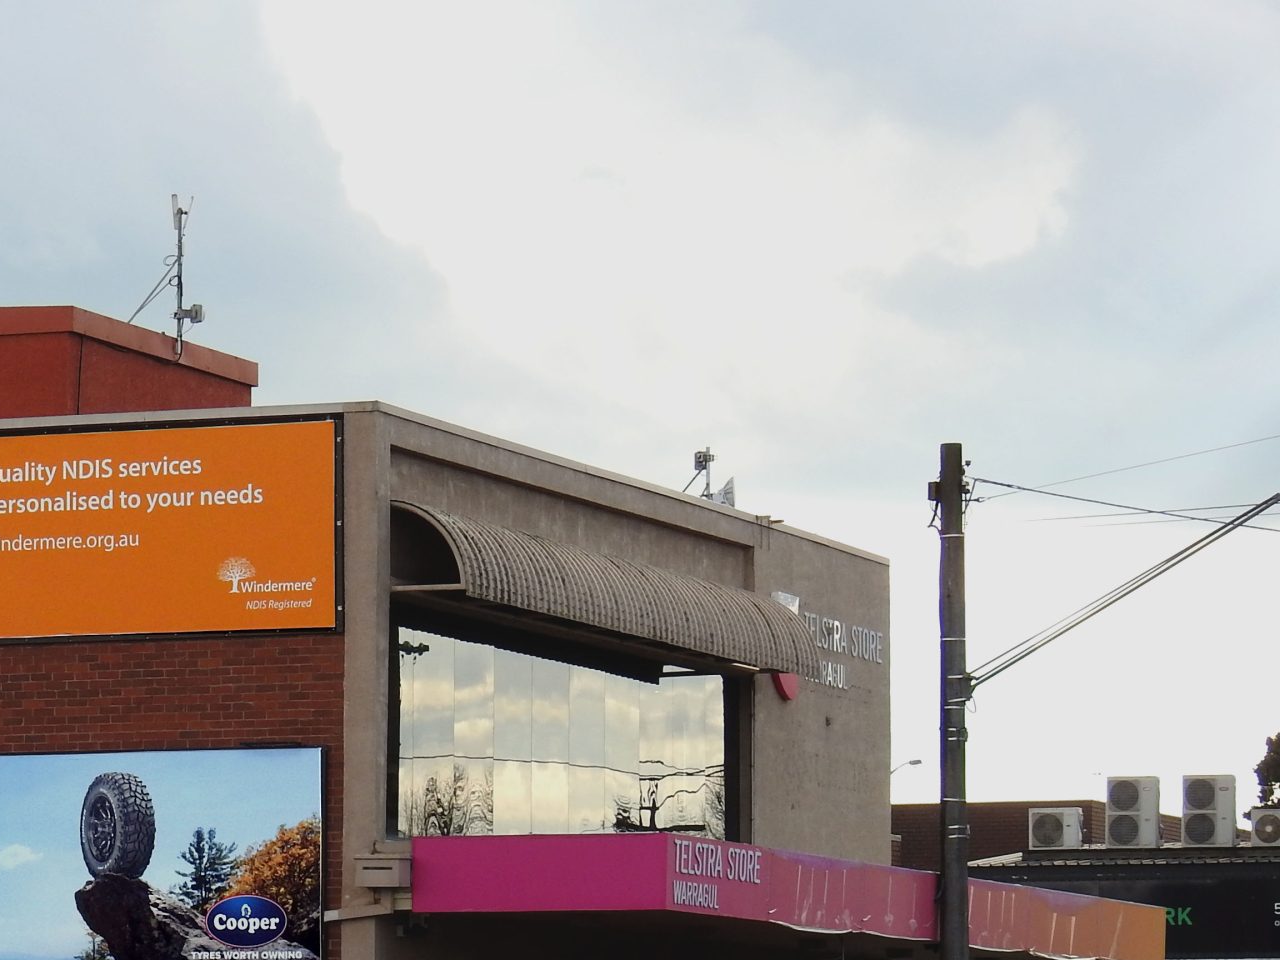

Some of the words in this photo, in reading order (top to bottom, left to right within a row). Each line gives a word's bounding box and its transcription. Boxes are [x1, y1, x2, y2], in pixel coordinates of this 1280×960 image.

[62, 458, 113, 480] NDIS
[118, 456, 202, 478] services
[120, 491, 141, 509] to
[146, 490, 194, 513] your
[200, 484, 264, 506] needs
[245, 600, 267, 610] NDIS
[268, 598, 313, 611] Registered
[851, 624, 883, 664] STORE
[674, 839, 723, 878] TELSTRA
[727, 847, 762, 884] STORE
[673, 880, 719, 909] WARRAGUL
[213, 913, 280, 934] Cooper
[191, 951, 221, 960] TYRES
[223, 951, 259, 960] WORTH
[261, 950, 303, 960] OWNING
